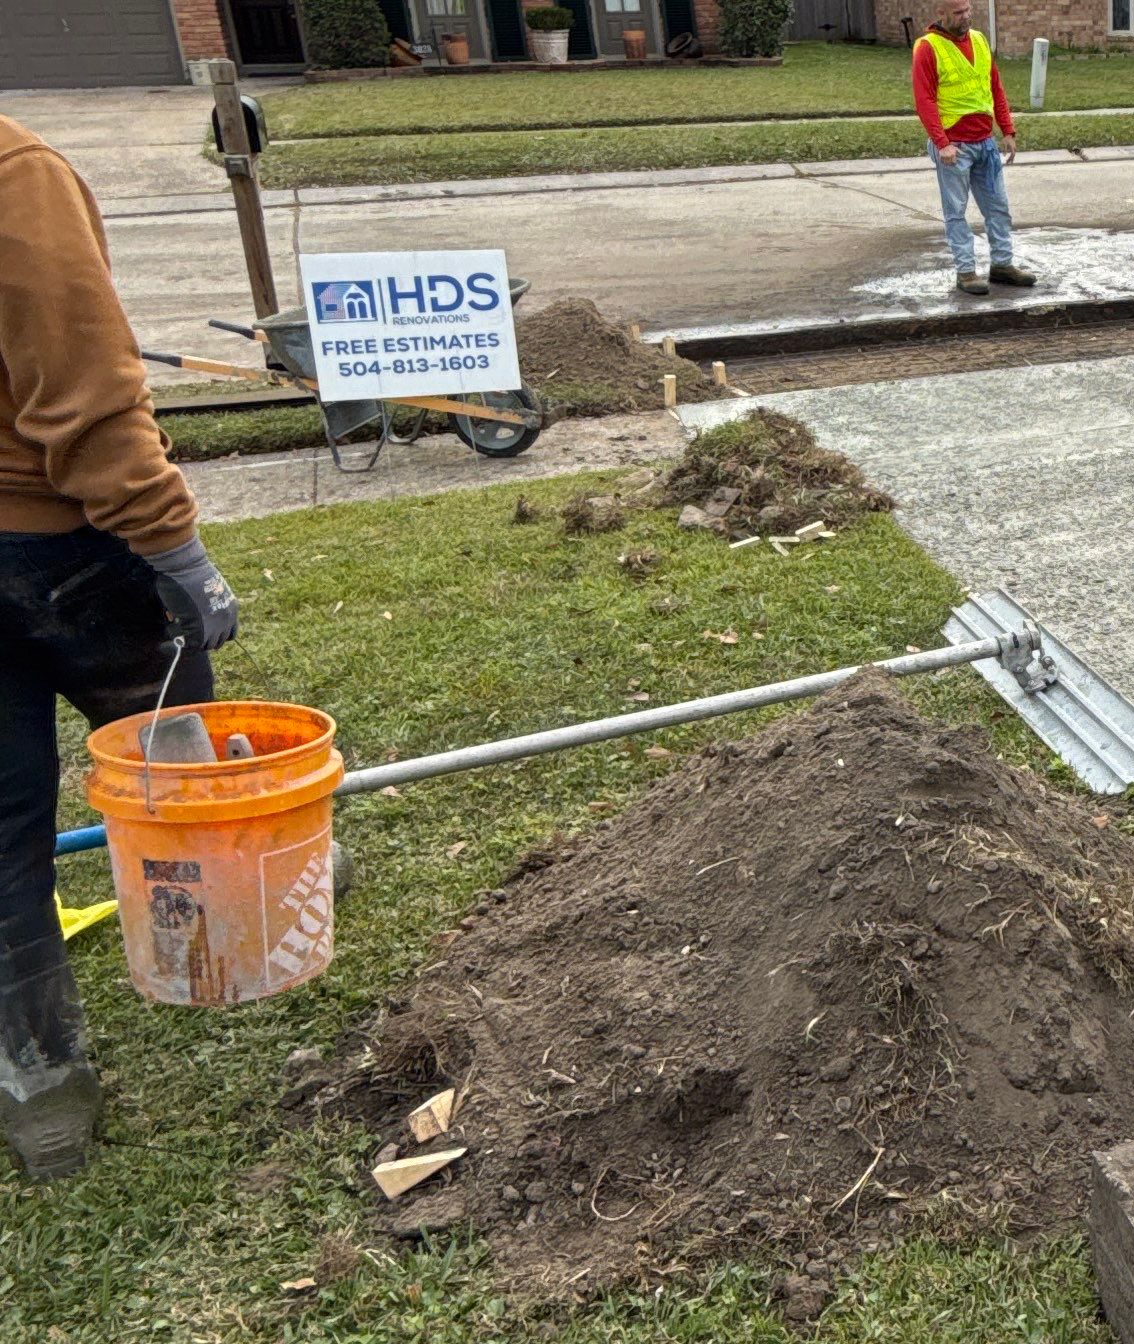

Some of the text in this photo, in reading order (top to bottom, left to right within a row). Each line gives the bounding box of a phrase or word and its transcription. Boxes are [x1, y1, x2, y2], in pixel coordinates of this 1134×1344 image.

[387, 272, 500, 314] HDS
[392, 313, 471, 327] RENOVATIONS
[321, 332, 500, 356] FREE ESTIMATES
[338, 354, 490, 377] 504-813-1603
